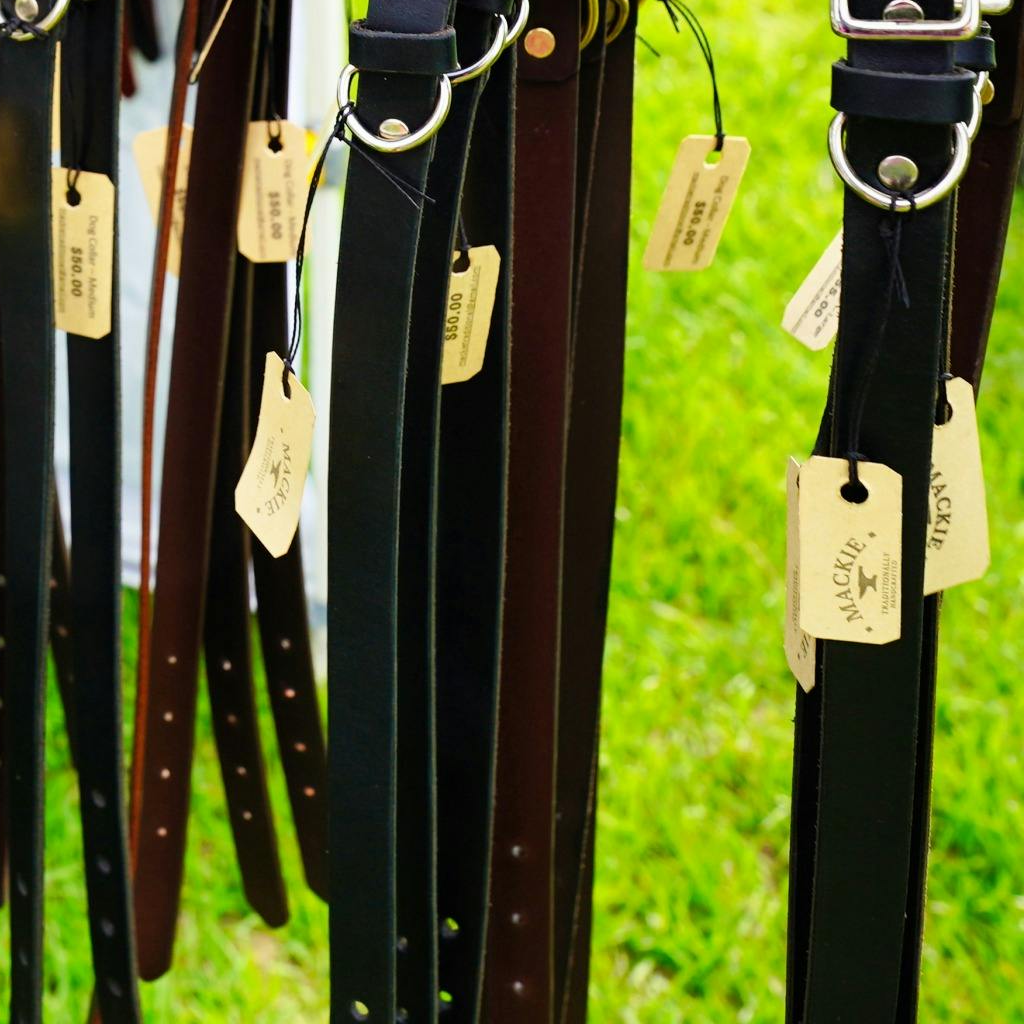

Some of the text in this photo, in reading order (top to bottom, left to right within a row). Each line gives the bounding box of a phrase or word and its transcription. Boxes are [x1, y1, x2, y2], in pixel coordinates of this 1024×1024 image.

[88, 215, 99, 238] Dog
[267, 192, 282, 240] $50.00
[683, 200, 706, 246] $50.00
[71, 246, 83, 297] $50.00
[87, 238, 98, 266] Collar
[87, 277, 98, 319] Medium
[445, 293, 463, 341] $50.00
[265, 443, 291, 516] MACKIE
[832, 537, 867, 623] MACKIE
[881, 552, 891, 615] TRADITIONALLY
